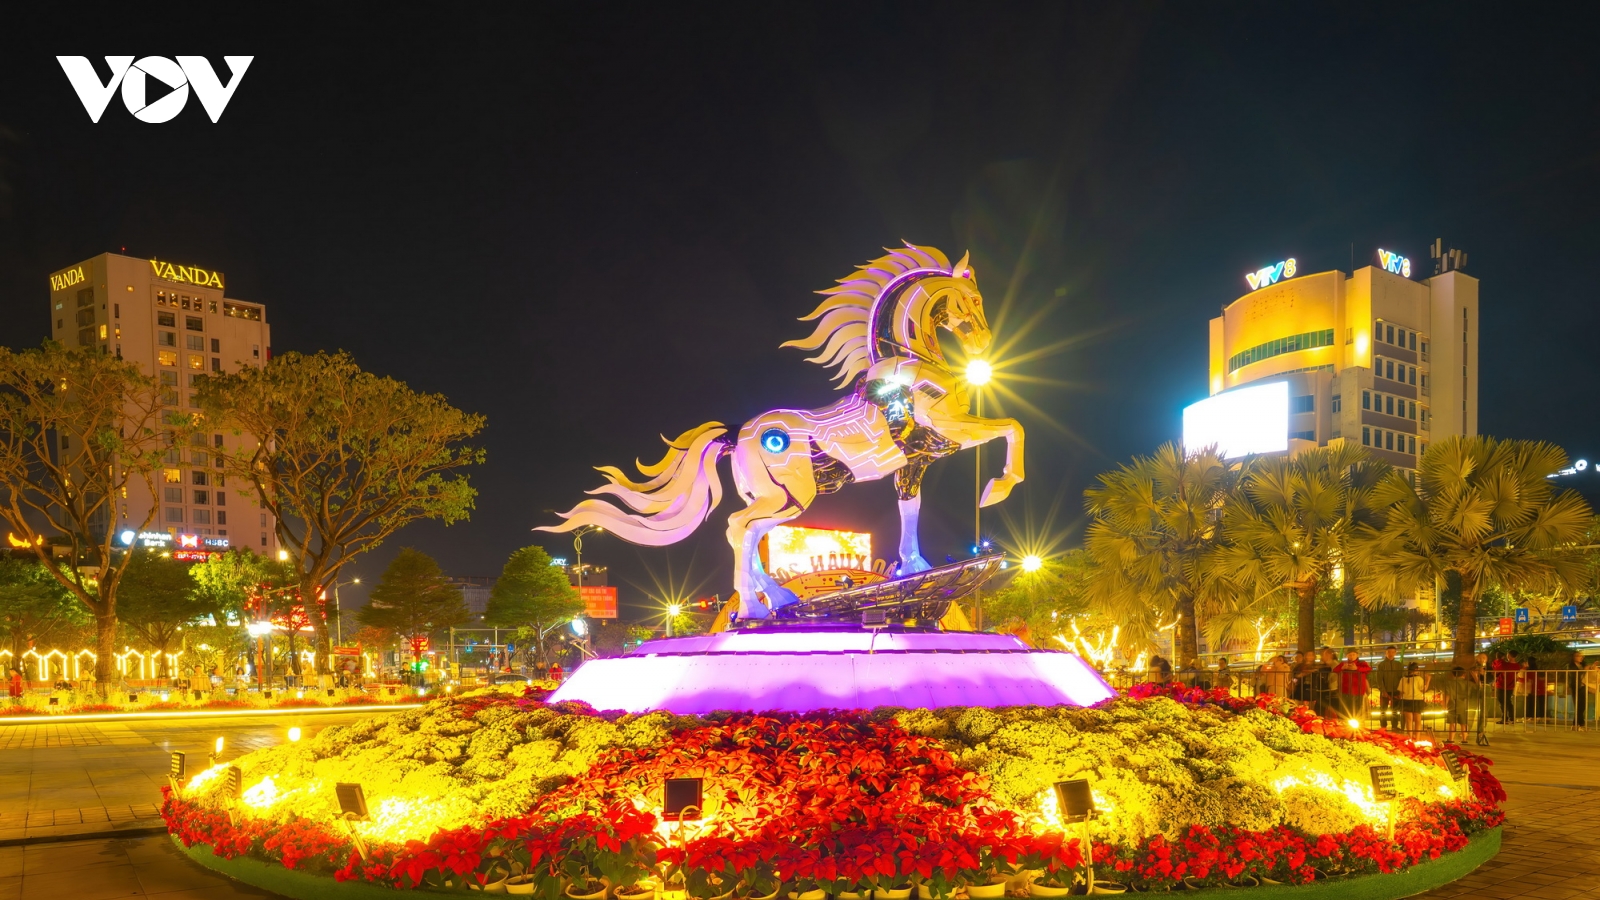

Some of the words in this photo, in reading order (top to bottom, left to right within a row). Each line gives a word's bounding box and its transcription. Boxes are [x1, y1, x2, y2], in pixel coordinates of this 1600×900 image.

[51, 266, 85, 291] VANDA
[150, 260, 223, 288] VANDA
[205, 538, 229, 547] HSBC
